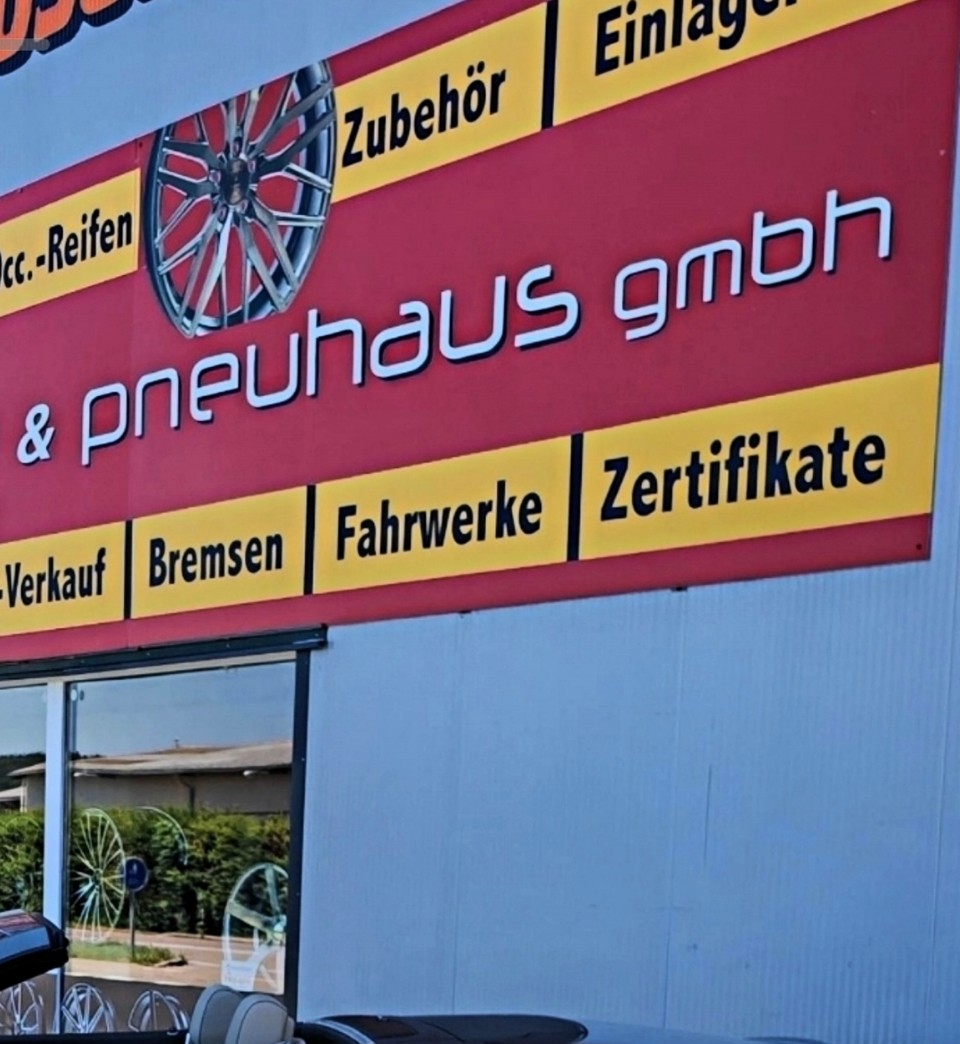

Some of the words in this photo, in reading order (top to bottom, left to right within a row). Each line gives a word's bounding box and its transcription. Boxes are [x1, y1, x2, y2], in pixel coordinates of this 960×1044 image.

[595, 0, 798, 77] Einlag
[341, 61, 507, 168] Zubehör
[16, 403, 55, 466] &
[81, 264, 580, 468] pneuhaus
[614, 190, 893, 341] gmbh
[599, 425, 887, 523] Zertifikate
[148, 527, 285, 589] Bremsen
[335, 480, 544, 562] Fahrwerke
